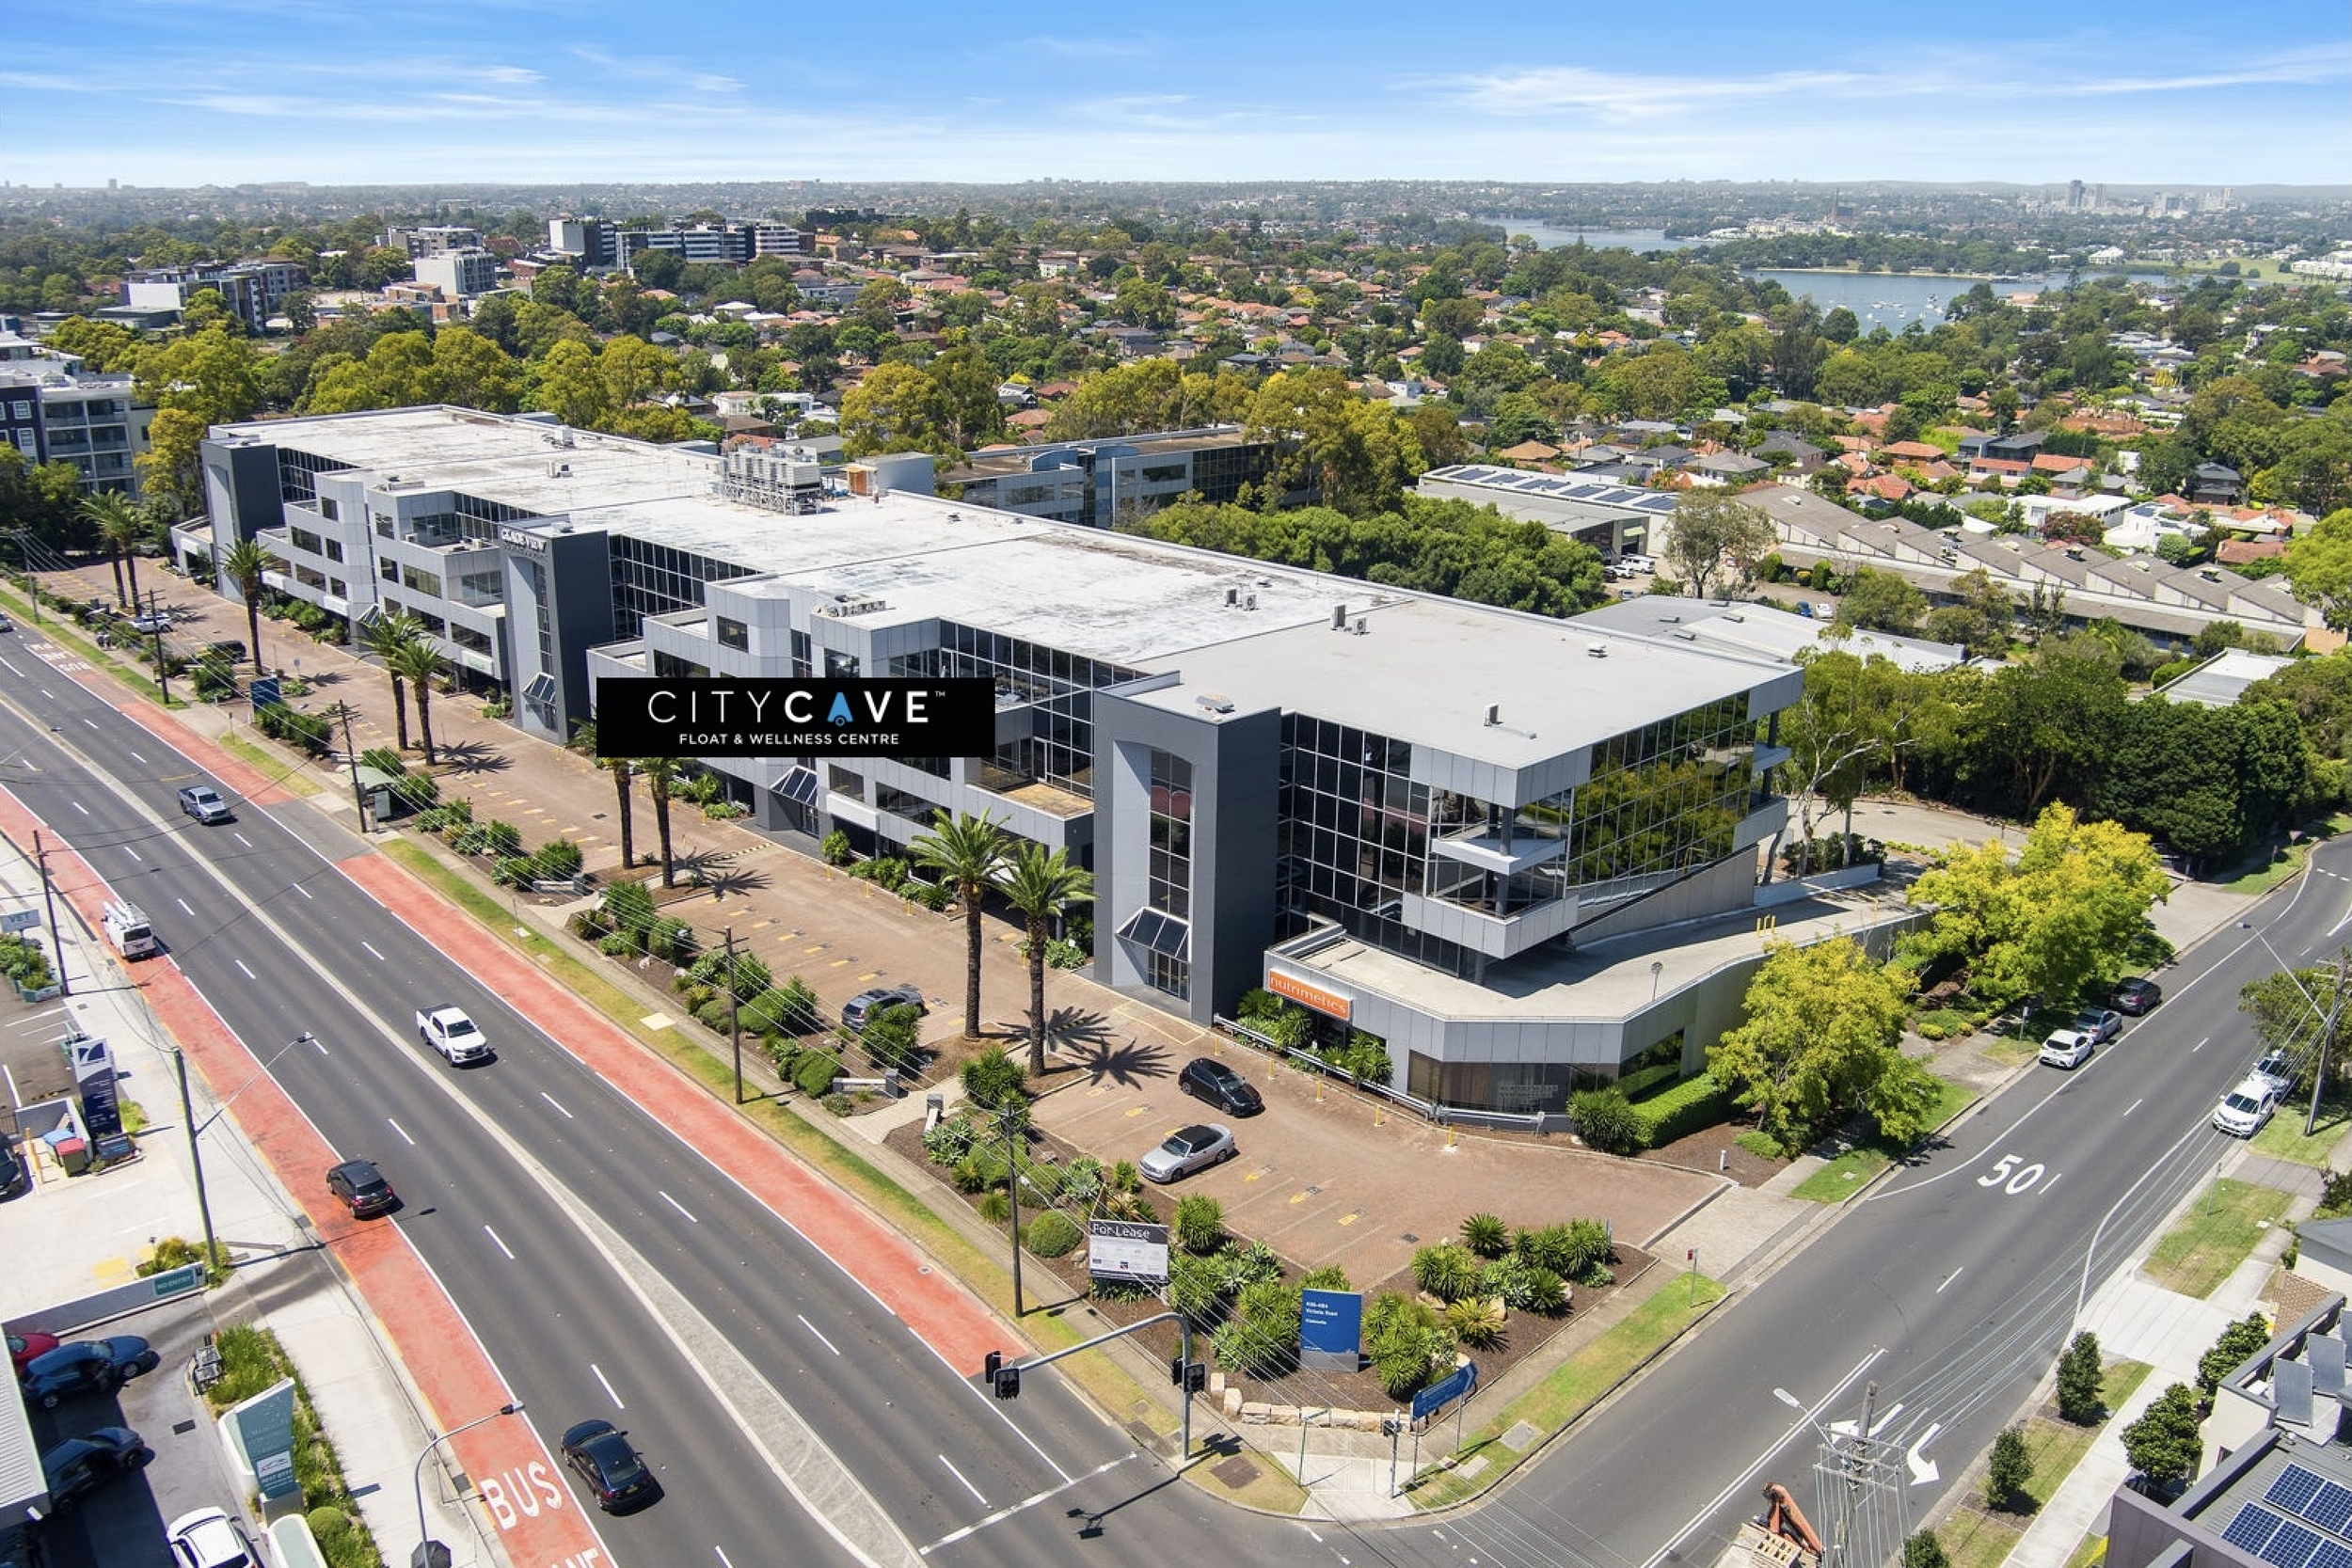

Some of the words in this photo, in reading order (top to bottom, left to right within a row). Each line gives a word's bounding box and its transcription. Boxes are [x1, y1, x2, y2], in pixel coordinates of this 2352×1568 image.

[1270, 976, 1347, 1015] nutrimetics
[1977, 1154, 2045, 1196] 50
[1093, 1223, 1113, 1236] For
[1115, 1226, 1150, 1239] Lease
[479, 1462, 562, 1530] BUS
